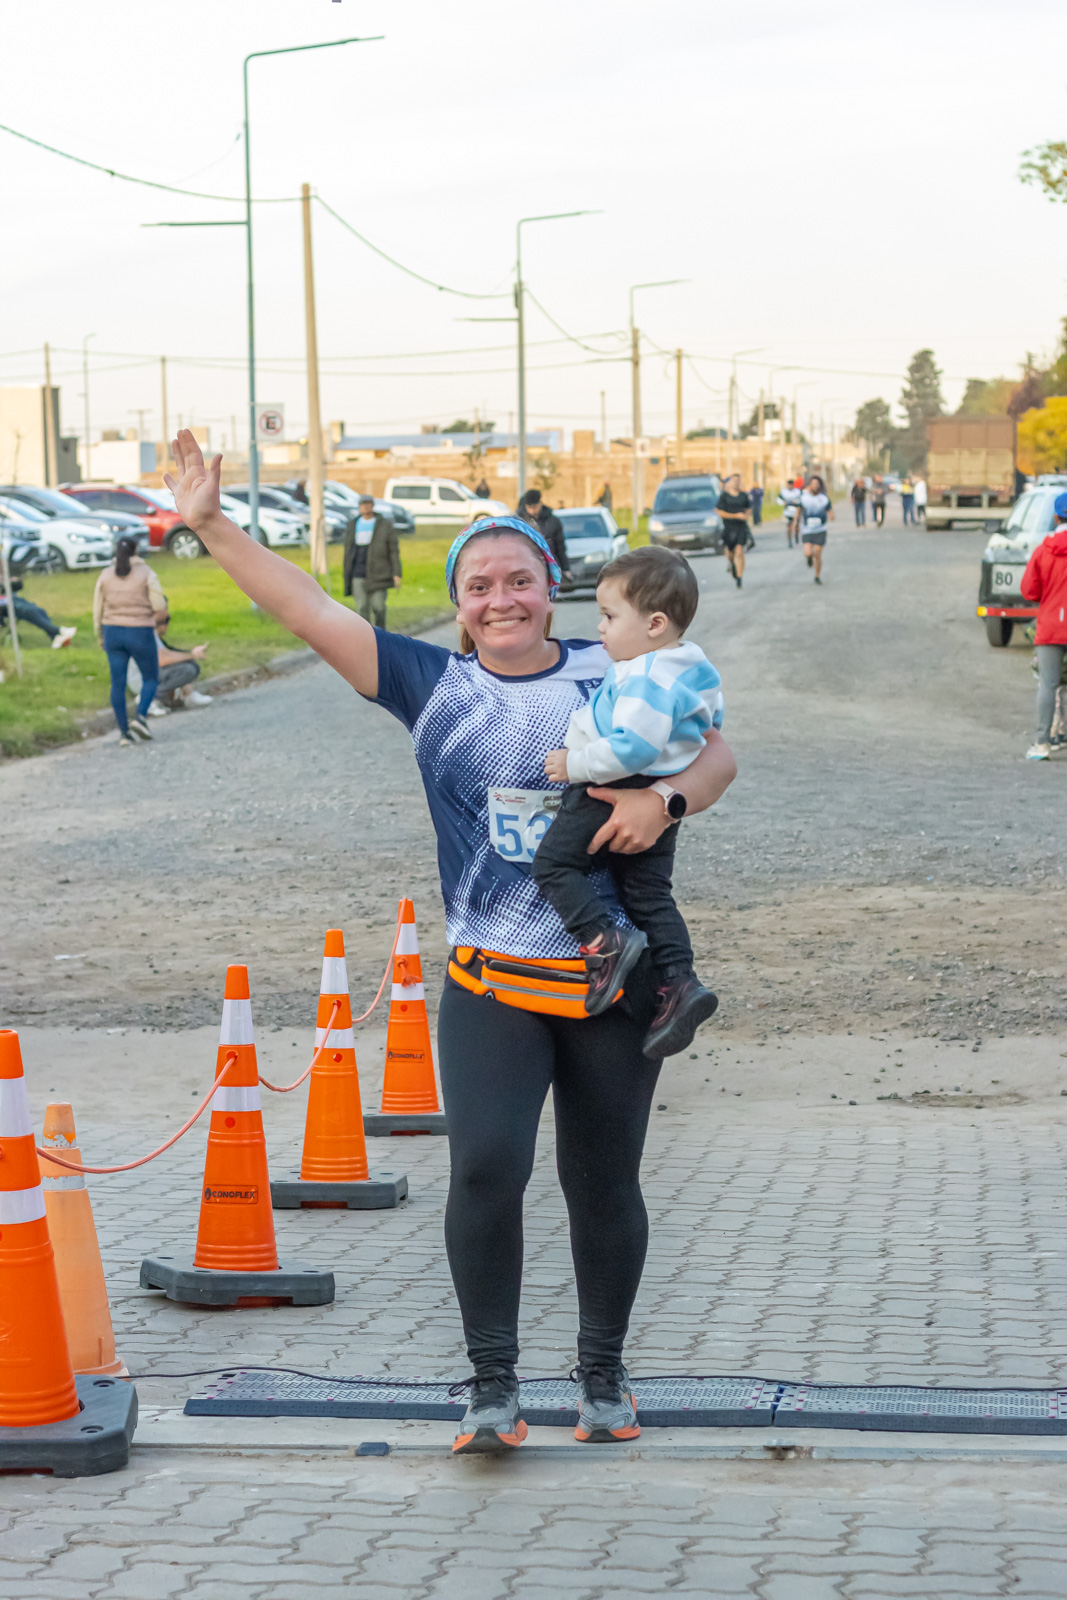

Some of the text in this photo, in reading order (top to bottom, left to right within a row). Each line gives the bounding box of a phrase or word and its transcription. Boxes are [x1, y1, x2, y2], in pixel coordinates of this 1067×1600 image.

[266, 416, 276, 430] E
[995, 571, 1013, 586] 80
[211, 1190, 256, 1199] CONOFLEX
